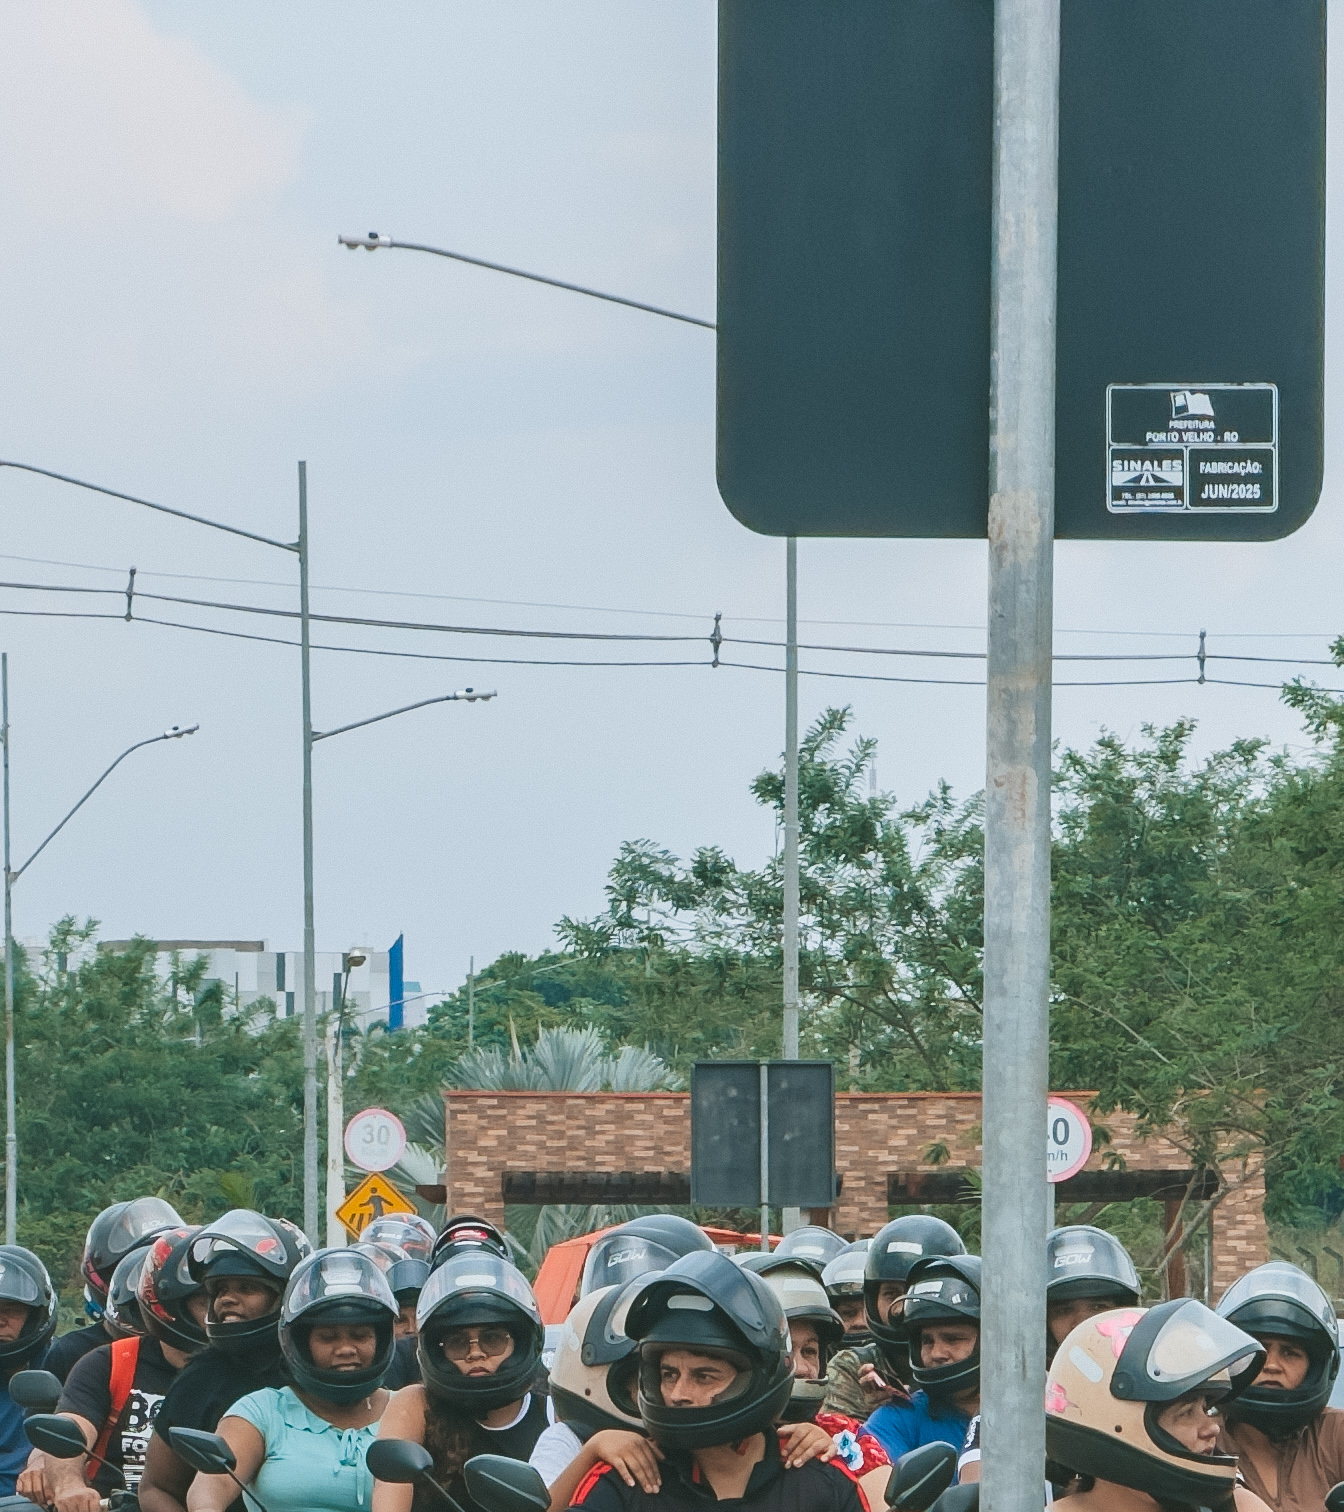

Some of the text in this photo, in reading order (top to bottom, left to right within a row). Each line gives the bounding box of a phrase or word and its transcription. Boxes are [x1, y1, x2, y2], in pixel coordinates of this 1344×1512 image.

[1146, 431, 1179, 442] PORTO
[1182, 431, 1215, 442] VELHO
[1223, 431, 1239, 442] RO
[1112, 459, 1183, 472] SINALES
[1199, 459, 1263, 476] FABRICAÇÃO:
[1201, 483, 1261, 499] JUN/2025
[362, 1123, 391, 1146] 30
[608, 1248, 648, 1268] GOW
[1054, 1253, 1092, 1268] GOW
